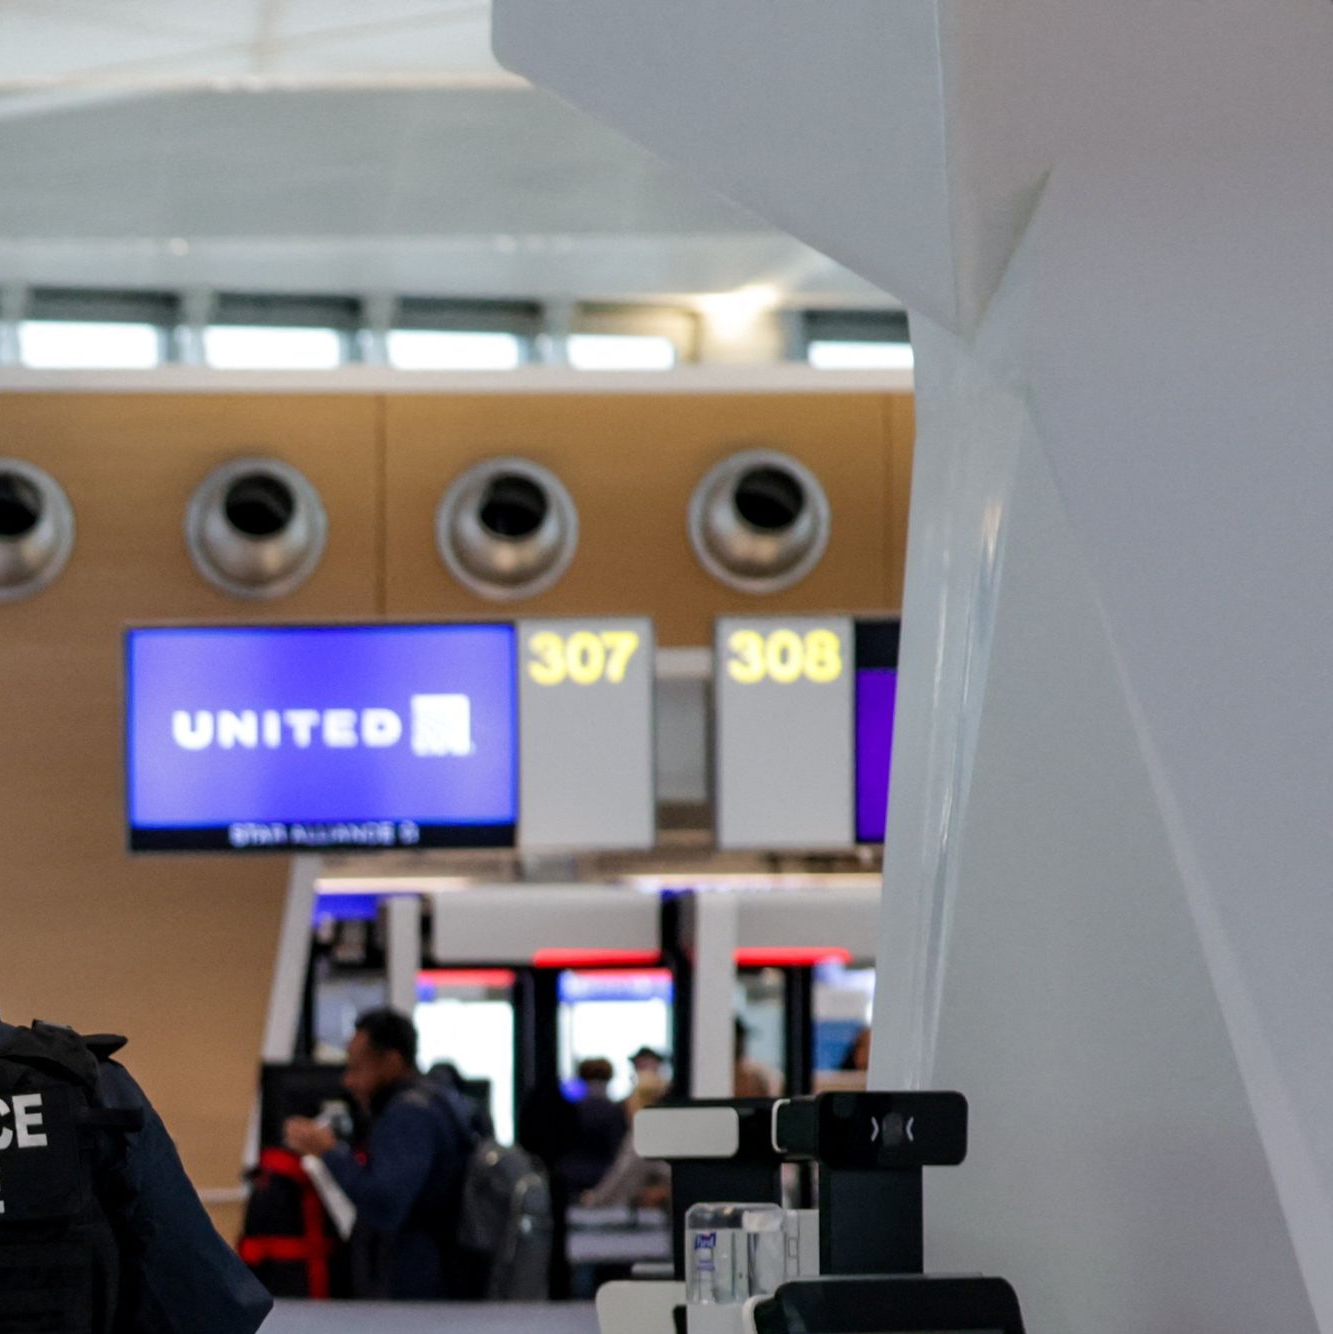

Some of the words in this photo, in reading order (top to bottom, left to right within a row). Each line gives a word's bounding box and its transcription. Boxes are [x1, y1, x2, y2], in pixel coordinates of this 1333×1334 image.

[529, 631, 639, 685] 307
[727, 630, 842, 684] 308
[172, 709, 402, 750] UNITED
